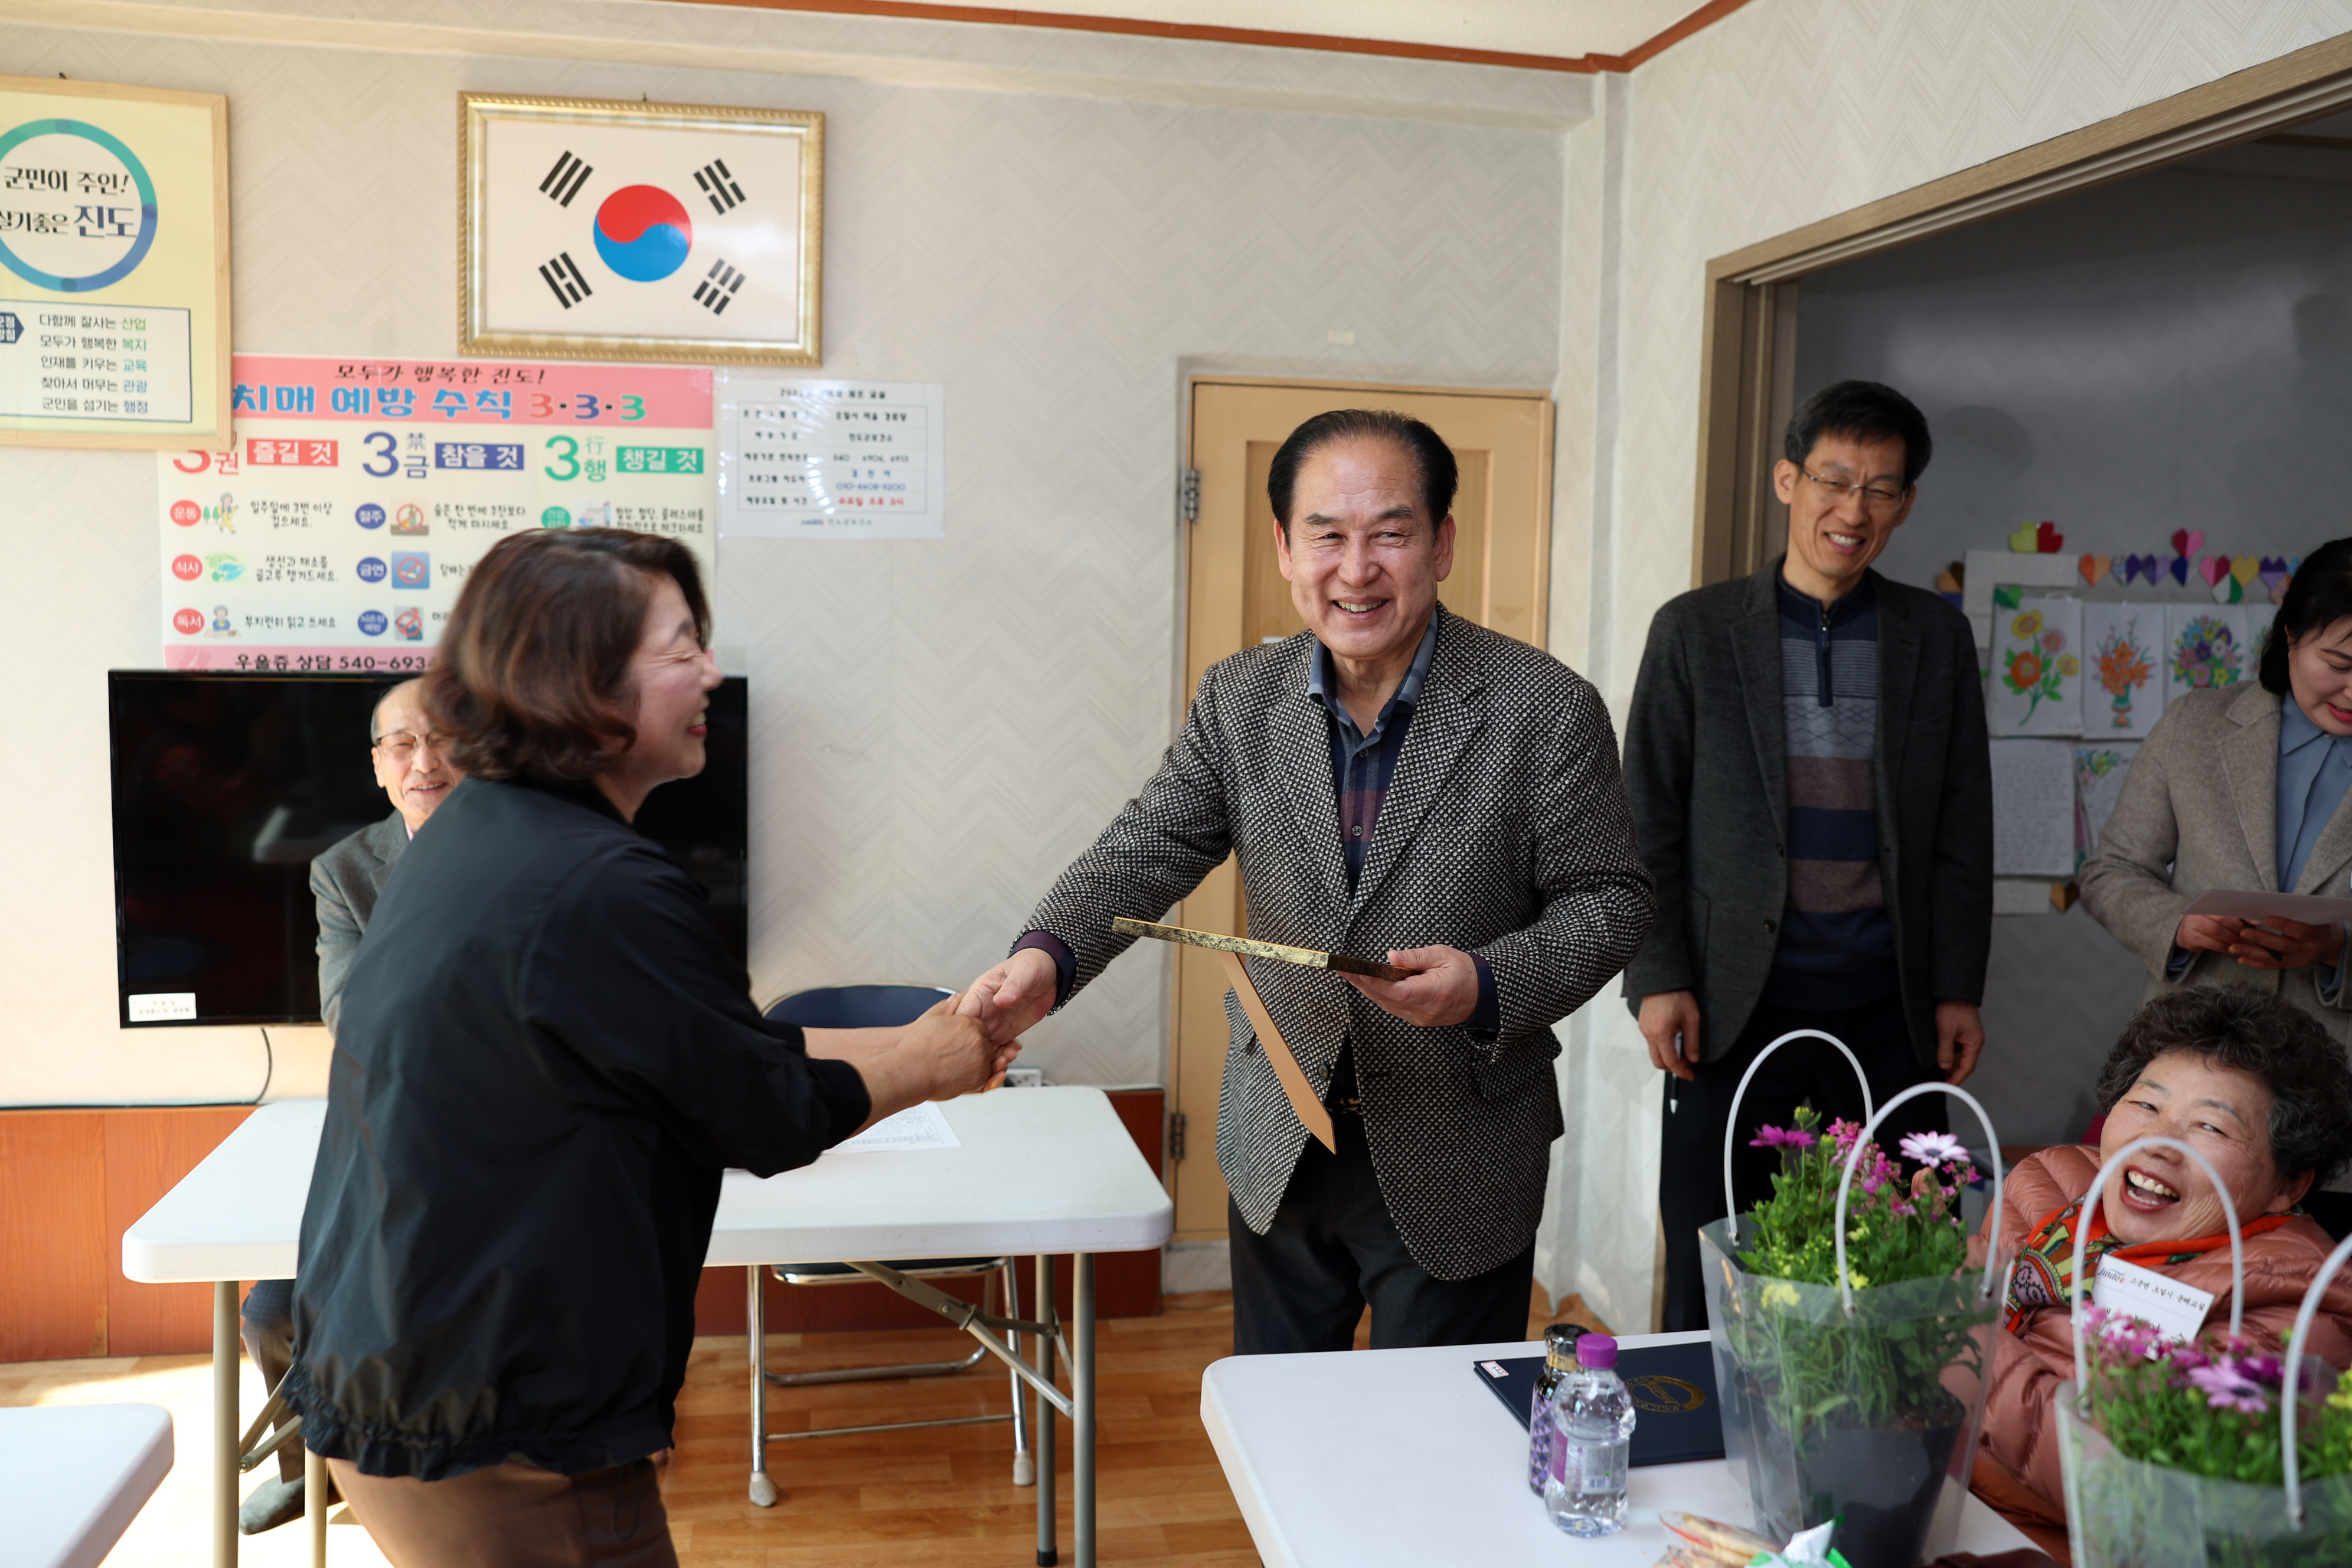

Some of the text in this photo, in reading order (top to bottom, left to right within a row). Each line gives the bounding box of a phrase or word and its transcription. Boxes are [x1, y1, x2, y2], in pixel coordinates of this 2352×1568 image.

[3, 166, 130, 195] 군민이 주인!
[74, 205, 138, 239] 진도
[40, 314, 146, 331] 다함께 잘사는 산업
[40, 335, 147, 351] 모두가 행복한 복지
[41, 355, 147, 373] 인재를 키우는 교육
[335, 364, 545, 385] 모두가 행복한 진도!
[41, 377, 148, 393] 찾아서 머무는 관광
[43, 397, 148, 414] 군민을 섬기는 행정
[233, 384, 315, 413] 치매
[331, 386, 417, 417] 예방
[432, 388, 512, 420] 수칙
[253, 441, 299, 464] 즐길
[310, 442, 332, 465] 것
[442, 445, 486, 468] 참을
[496, 447, 518, 468] 것
[622, 449, 667, 472] 챙길
[676, 450, 697, 472] 것
[176, 560, 200, 575] 식사
[359, 562, 384, 577] 금연
[177, 614, 202, 629] 독서
[236, 654, 434, 671] 우울증 상담 540-693
